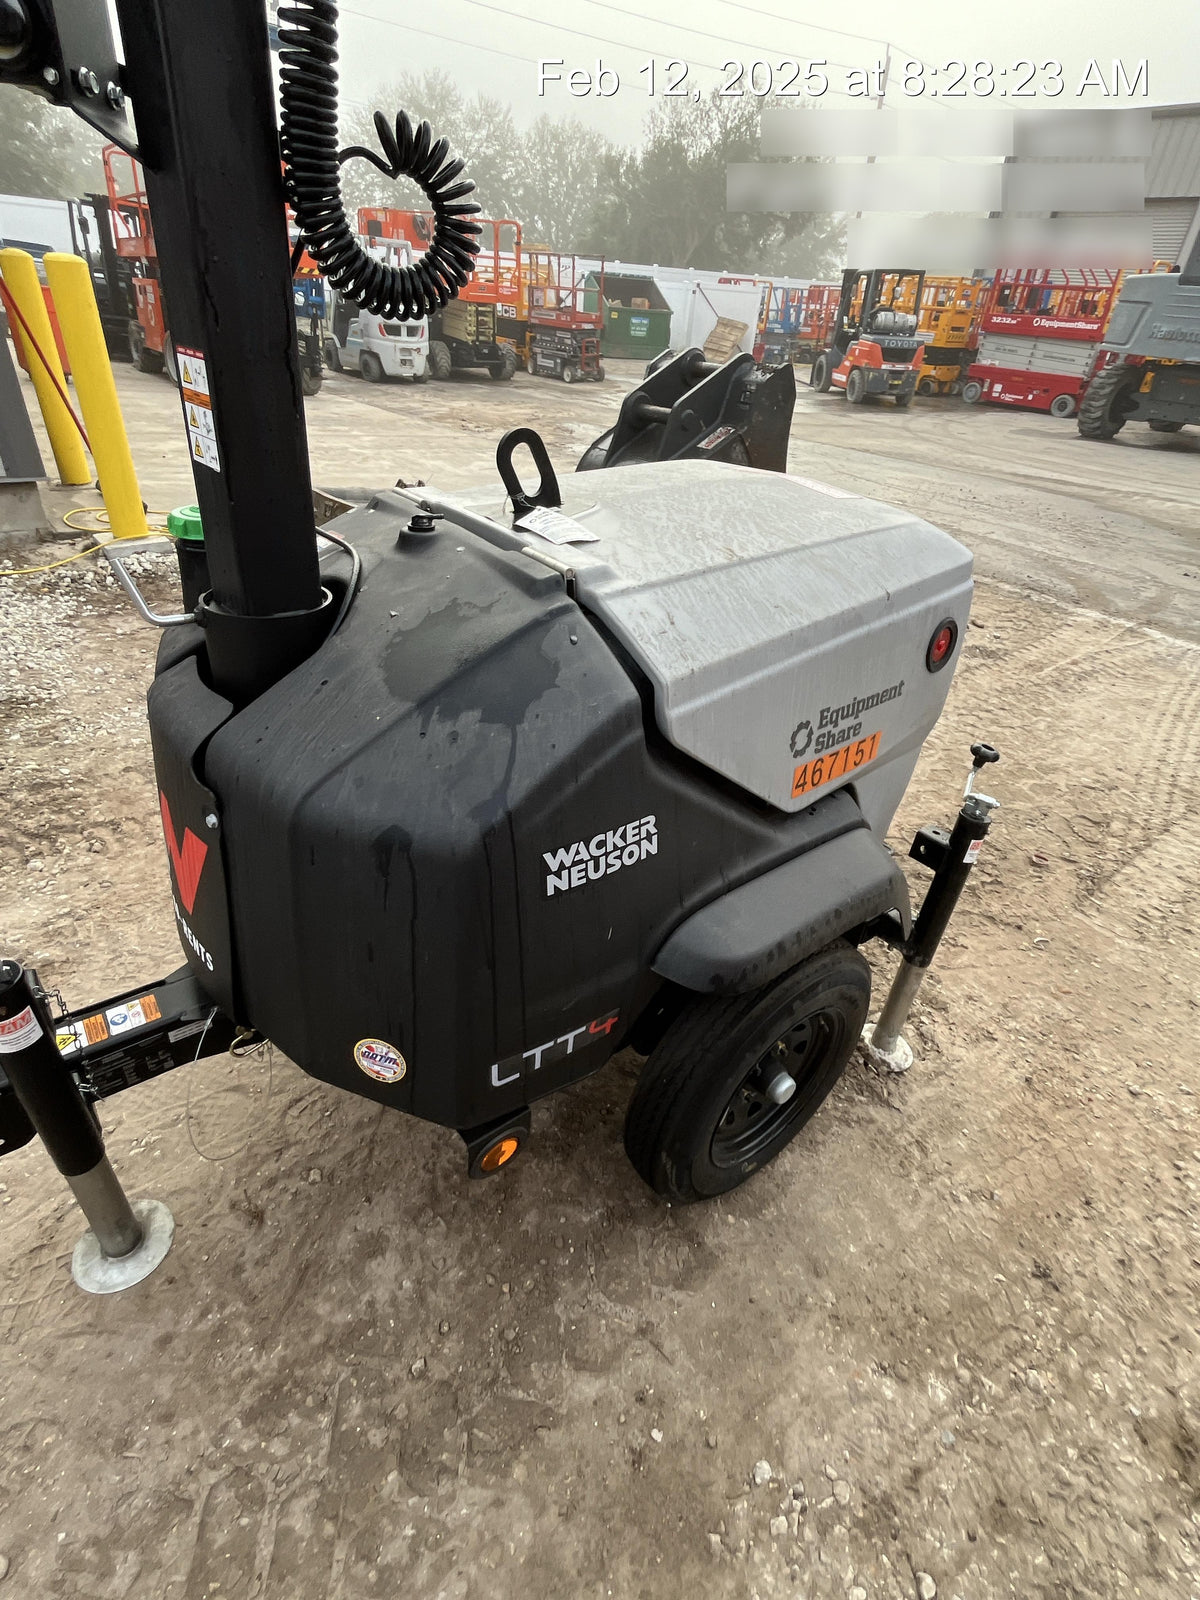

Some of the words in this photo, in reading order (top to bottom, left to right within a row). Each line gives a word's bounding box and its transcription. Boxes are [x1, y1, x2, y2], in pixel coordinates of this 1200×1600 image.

[884, 339, 918, 348] TOYOTA
[817, 680, 905, 730] Equipment
[794, 734, 877, 792] 467151
[814, 721, 862, 754] Share
[542, 815, 658, 873] WACKER
[546, 834, 658, 896] NEUSON
[491, 1016, 618, 1087] LTT4
